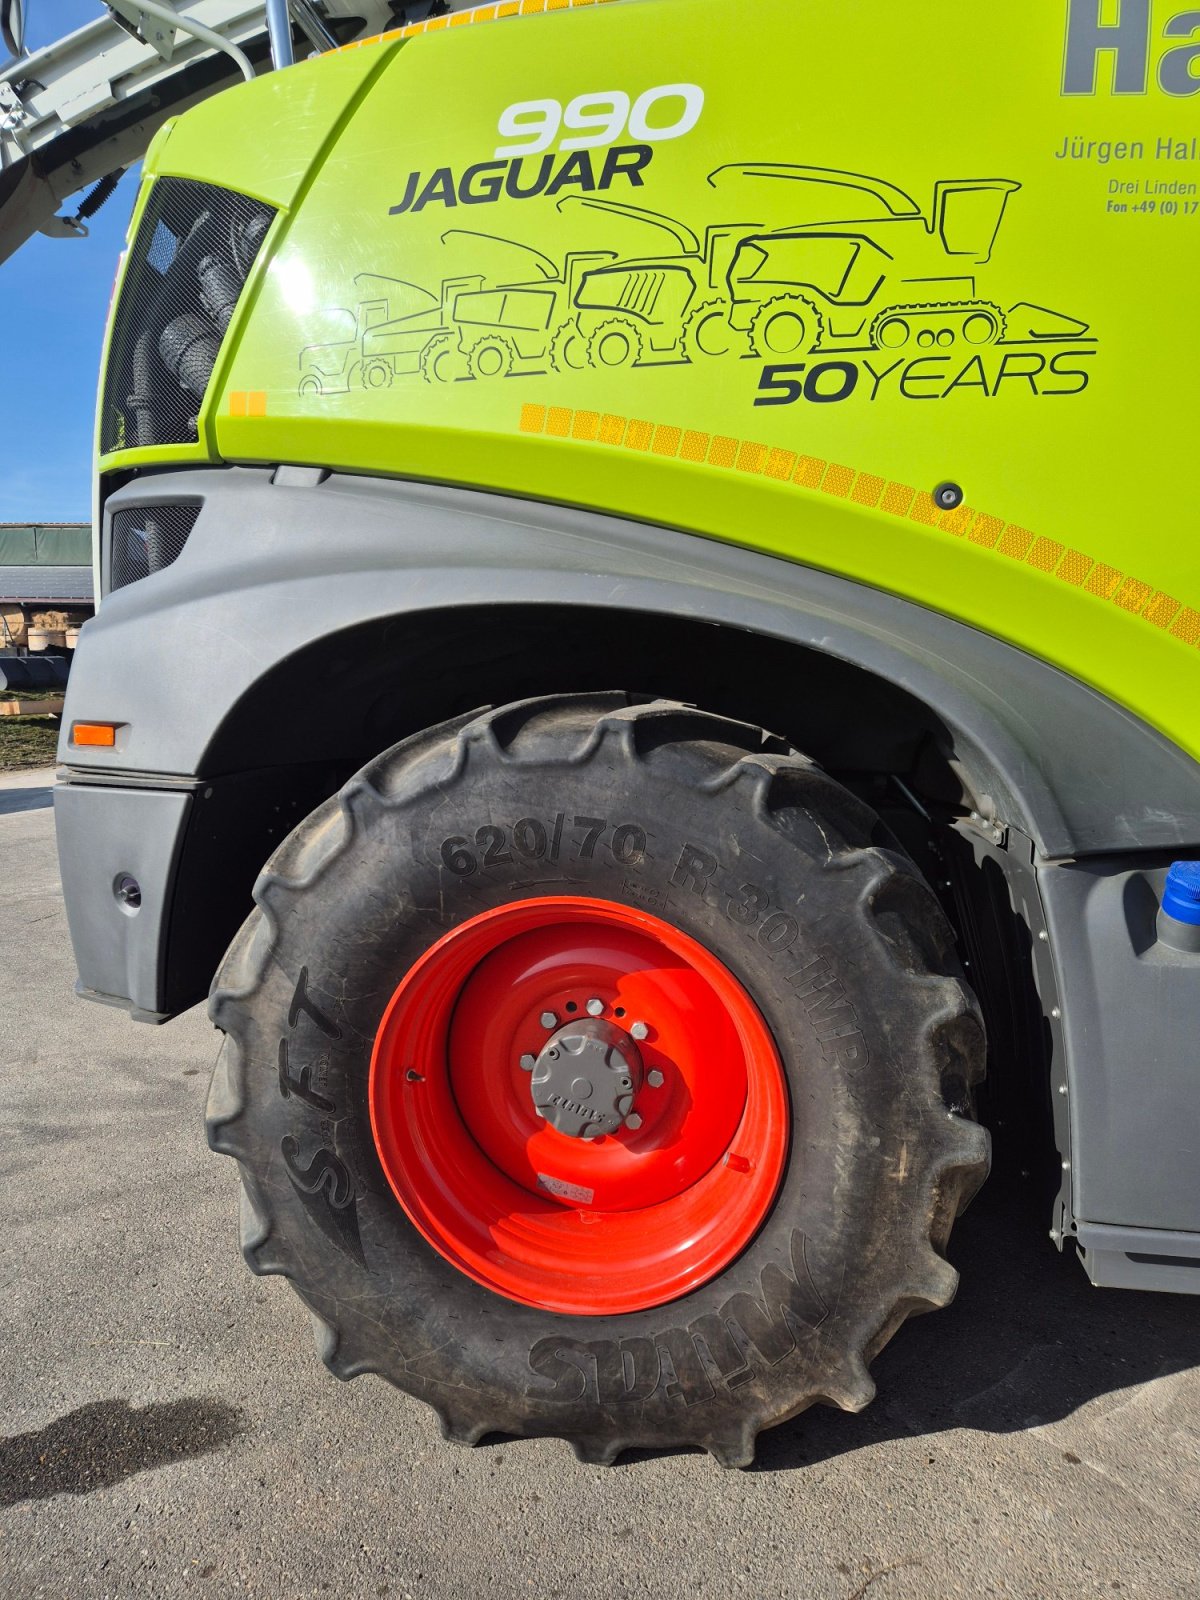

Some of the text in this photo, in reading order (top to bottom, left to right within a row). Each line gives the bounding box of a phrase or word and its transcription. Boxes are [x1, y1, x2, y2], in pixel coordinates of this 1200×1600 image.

[493, 83, 705, 159] 990
[1054, 135, 1200, 164] Jürgen Hal
[388, 144, 653, 215] JAGUAR
[1107, 178, 1197, 195] Drei Linden
[1106, 200, 1128, 213] Fon
[1131, 200, 1156, 213] +49
[1159, 200, 1178, 216] (0)
[439, 812, 648, 878] 620/70
[670, 841, 718, 895] R
[726, 882, 800, 954] 30
